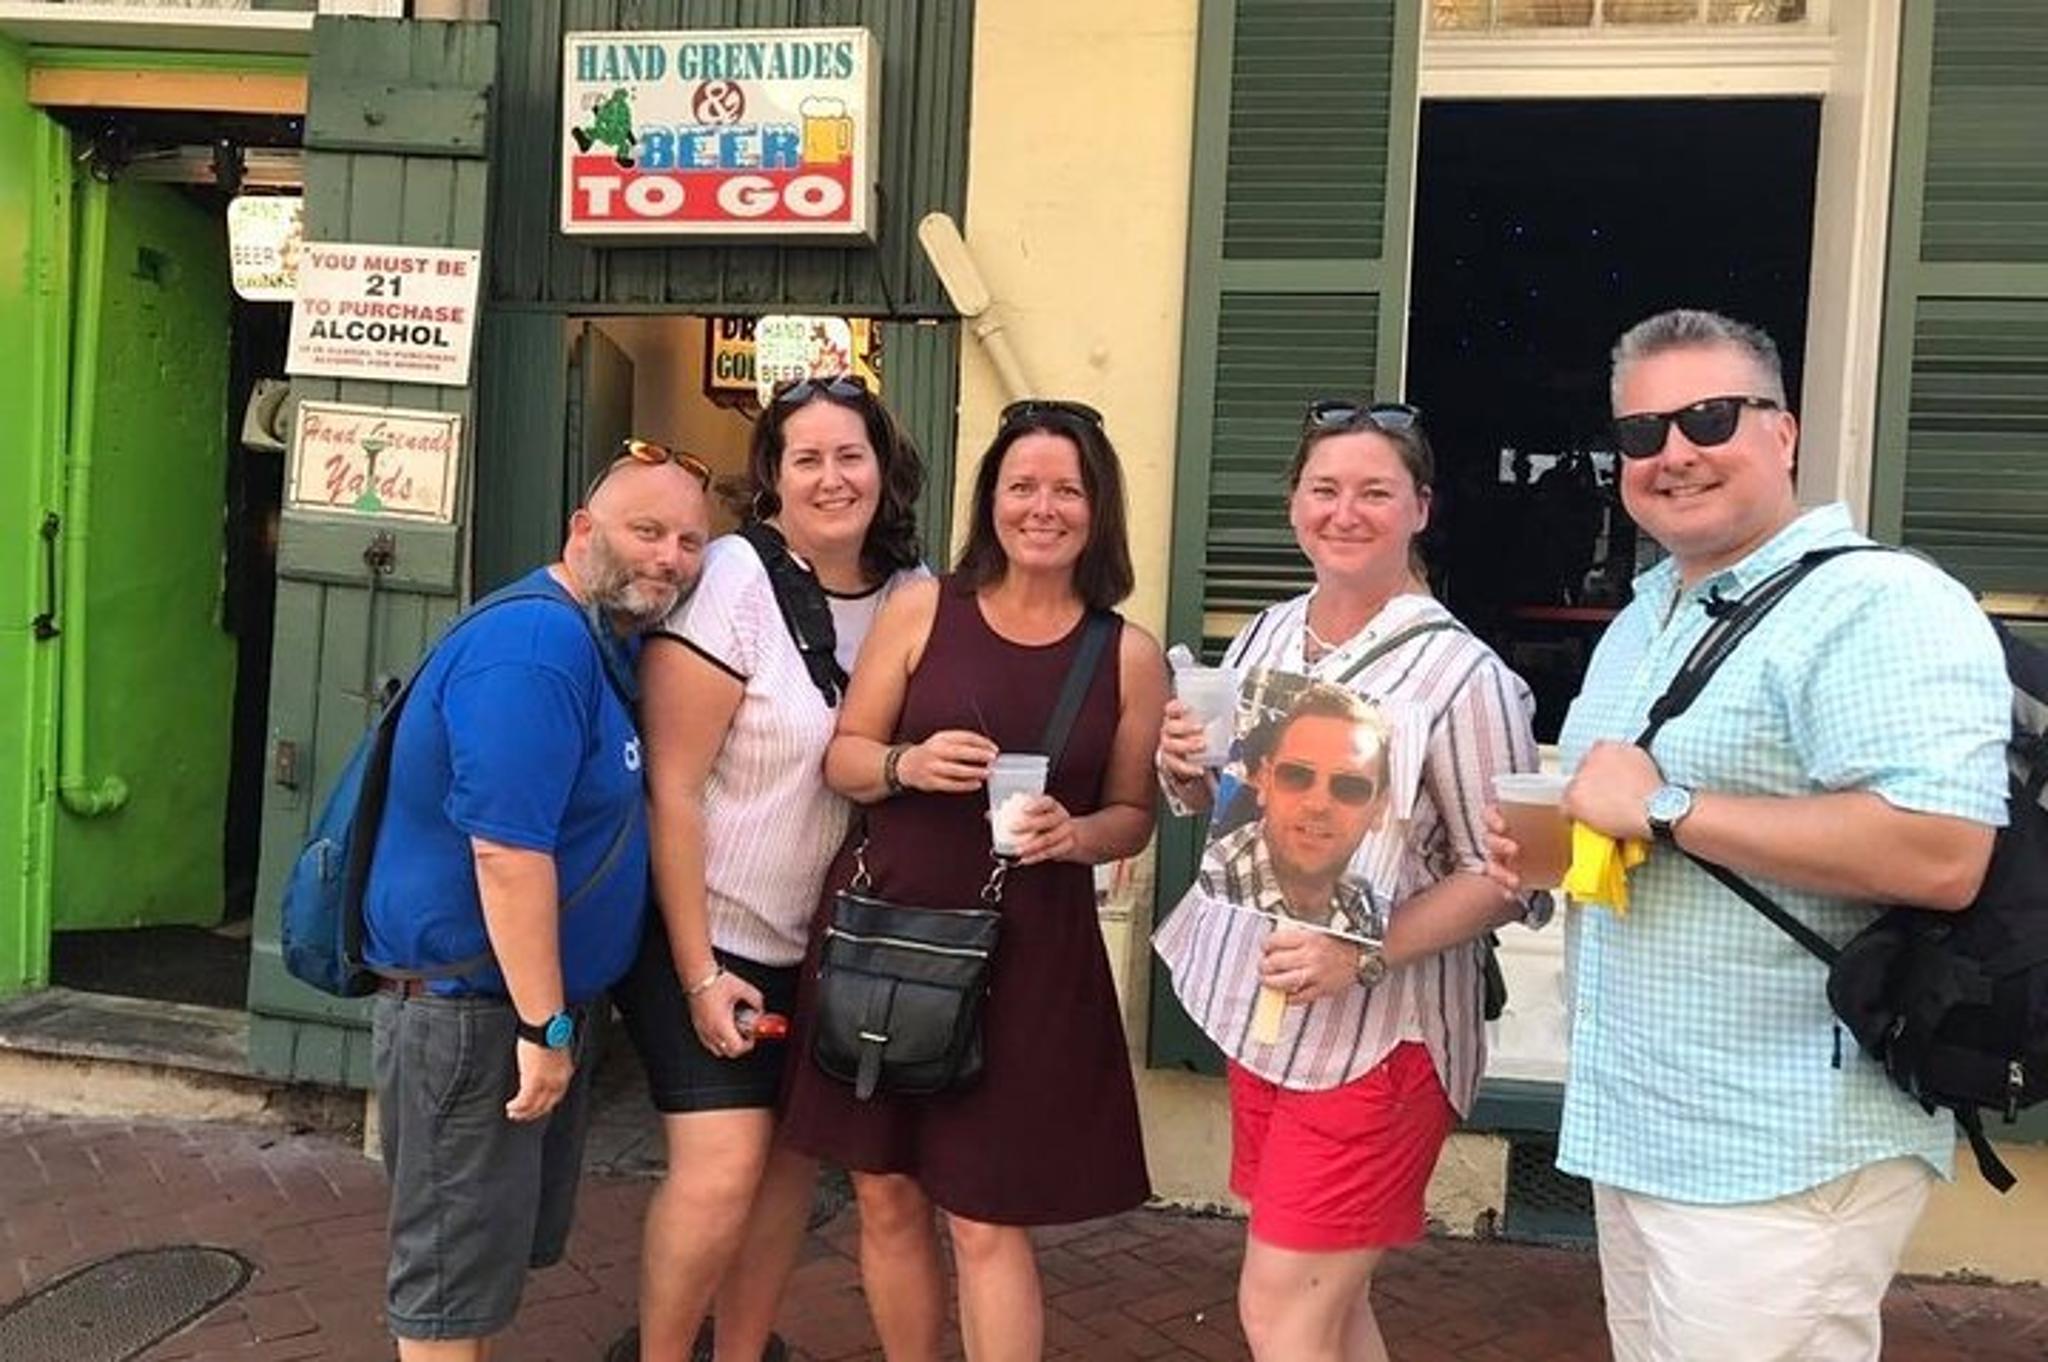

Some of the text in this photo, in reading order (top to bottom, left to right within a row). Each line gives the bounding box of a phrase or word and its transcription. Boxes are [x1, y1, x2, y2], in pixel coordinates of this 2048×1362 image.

[576, 41, 854, 81] HAND GRENADES
[692, 80, 746, 126] &
[638, 124, 801, 171] BEER
[577, 174, 846, 217] TO GO
[310, 253, 468, 277] YOU MUST BE
[365, 274, 404, 297] 21
[302, 299, 465, 324] TO PURCHASE
[308, 320, 450, 348] ALCOHOL
[303, 415, 361, 444] Hand
